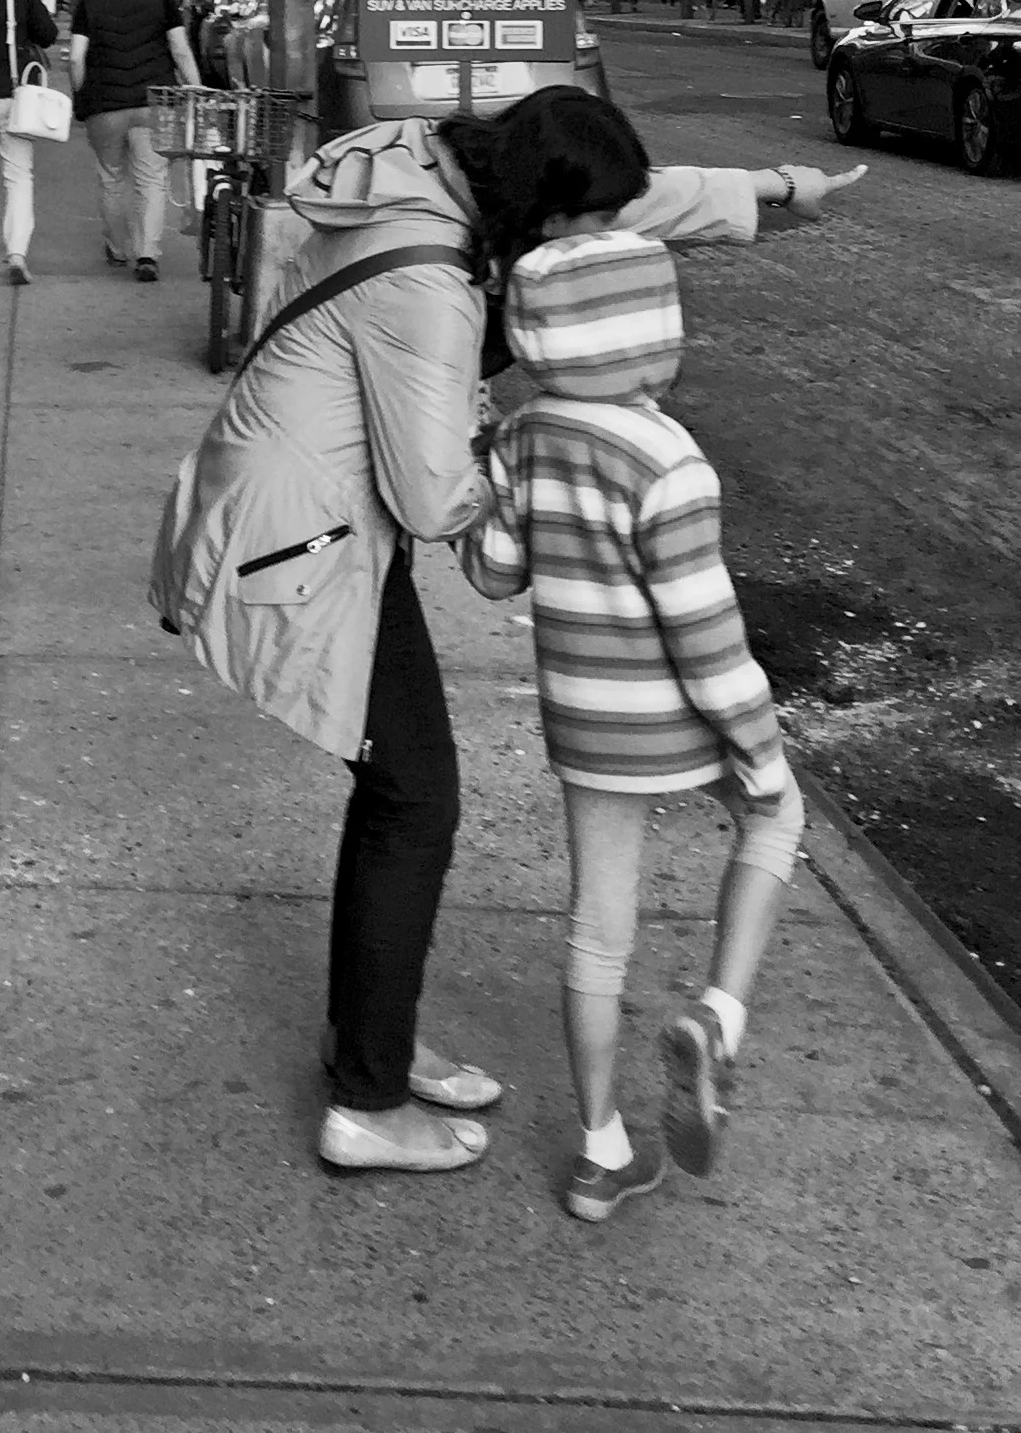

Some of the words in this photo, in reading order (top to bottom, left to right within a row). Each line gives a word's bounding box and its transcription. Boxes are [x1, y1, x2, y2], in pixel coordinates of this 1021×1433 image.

[366, 0, 394, 12] SUV
[394, 0, 406, 12] &
[406, 0, 433, 11] VAN
[513, 0, 567, 12] APPLIES
